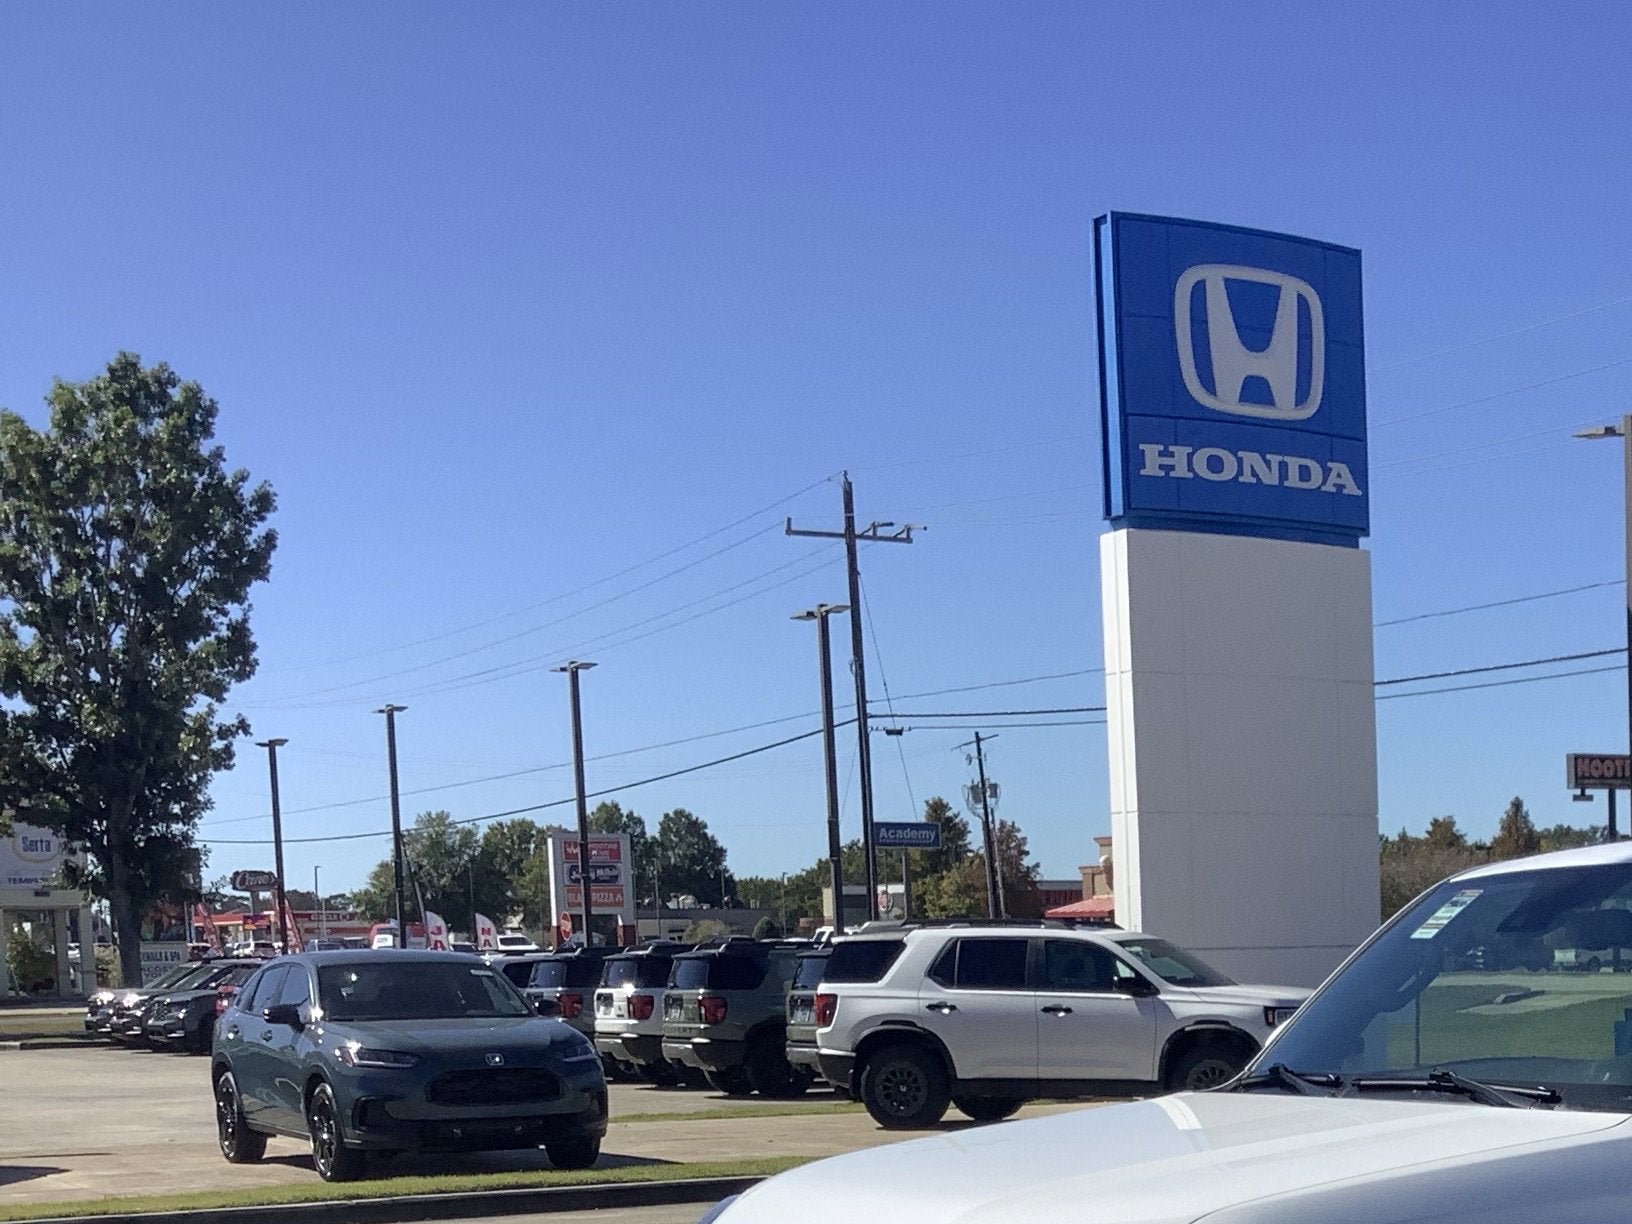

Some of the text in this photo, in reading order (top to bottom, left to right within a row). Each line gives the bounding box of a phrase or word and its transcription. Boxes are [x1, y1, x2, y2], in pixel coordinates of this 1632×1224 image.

[1139, 444, 1362, 496] HONDA
[880, 827, 936, 842] Academy
[22, 836, 51, 852] Serta
